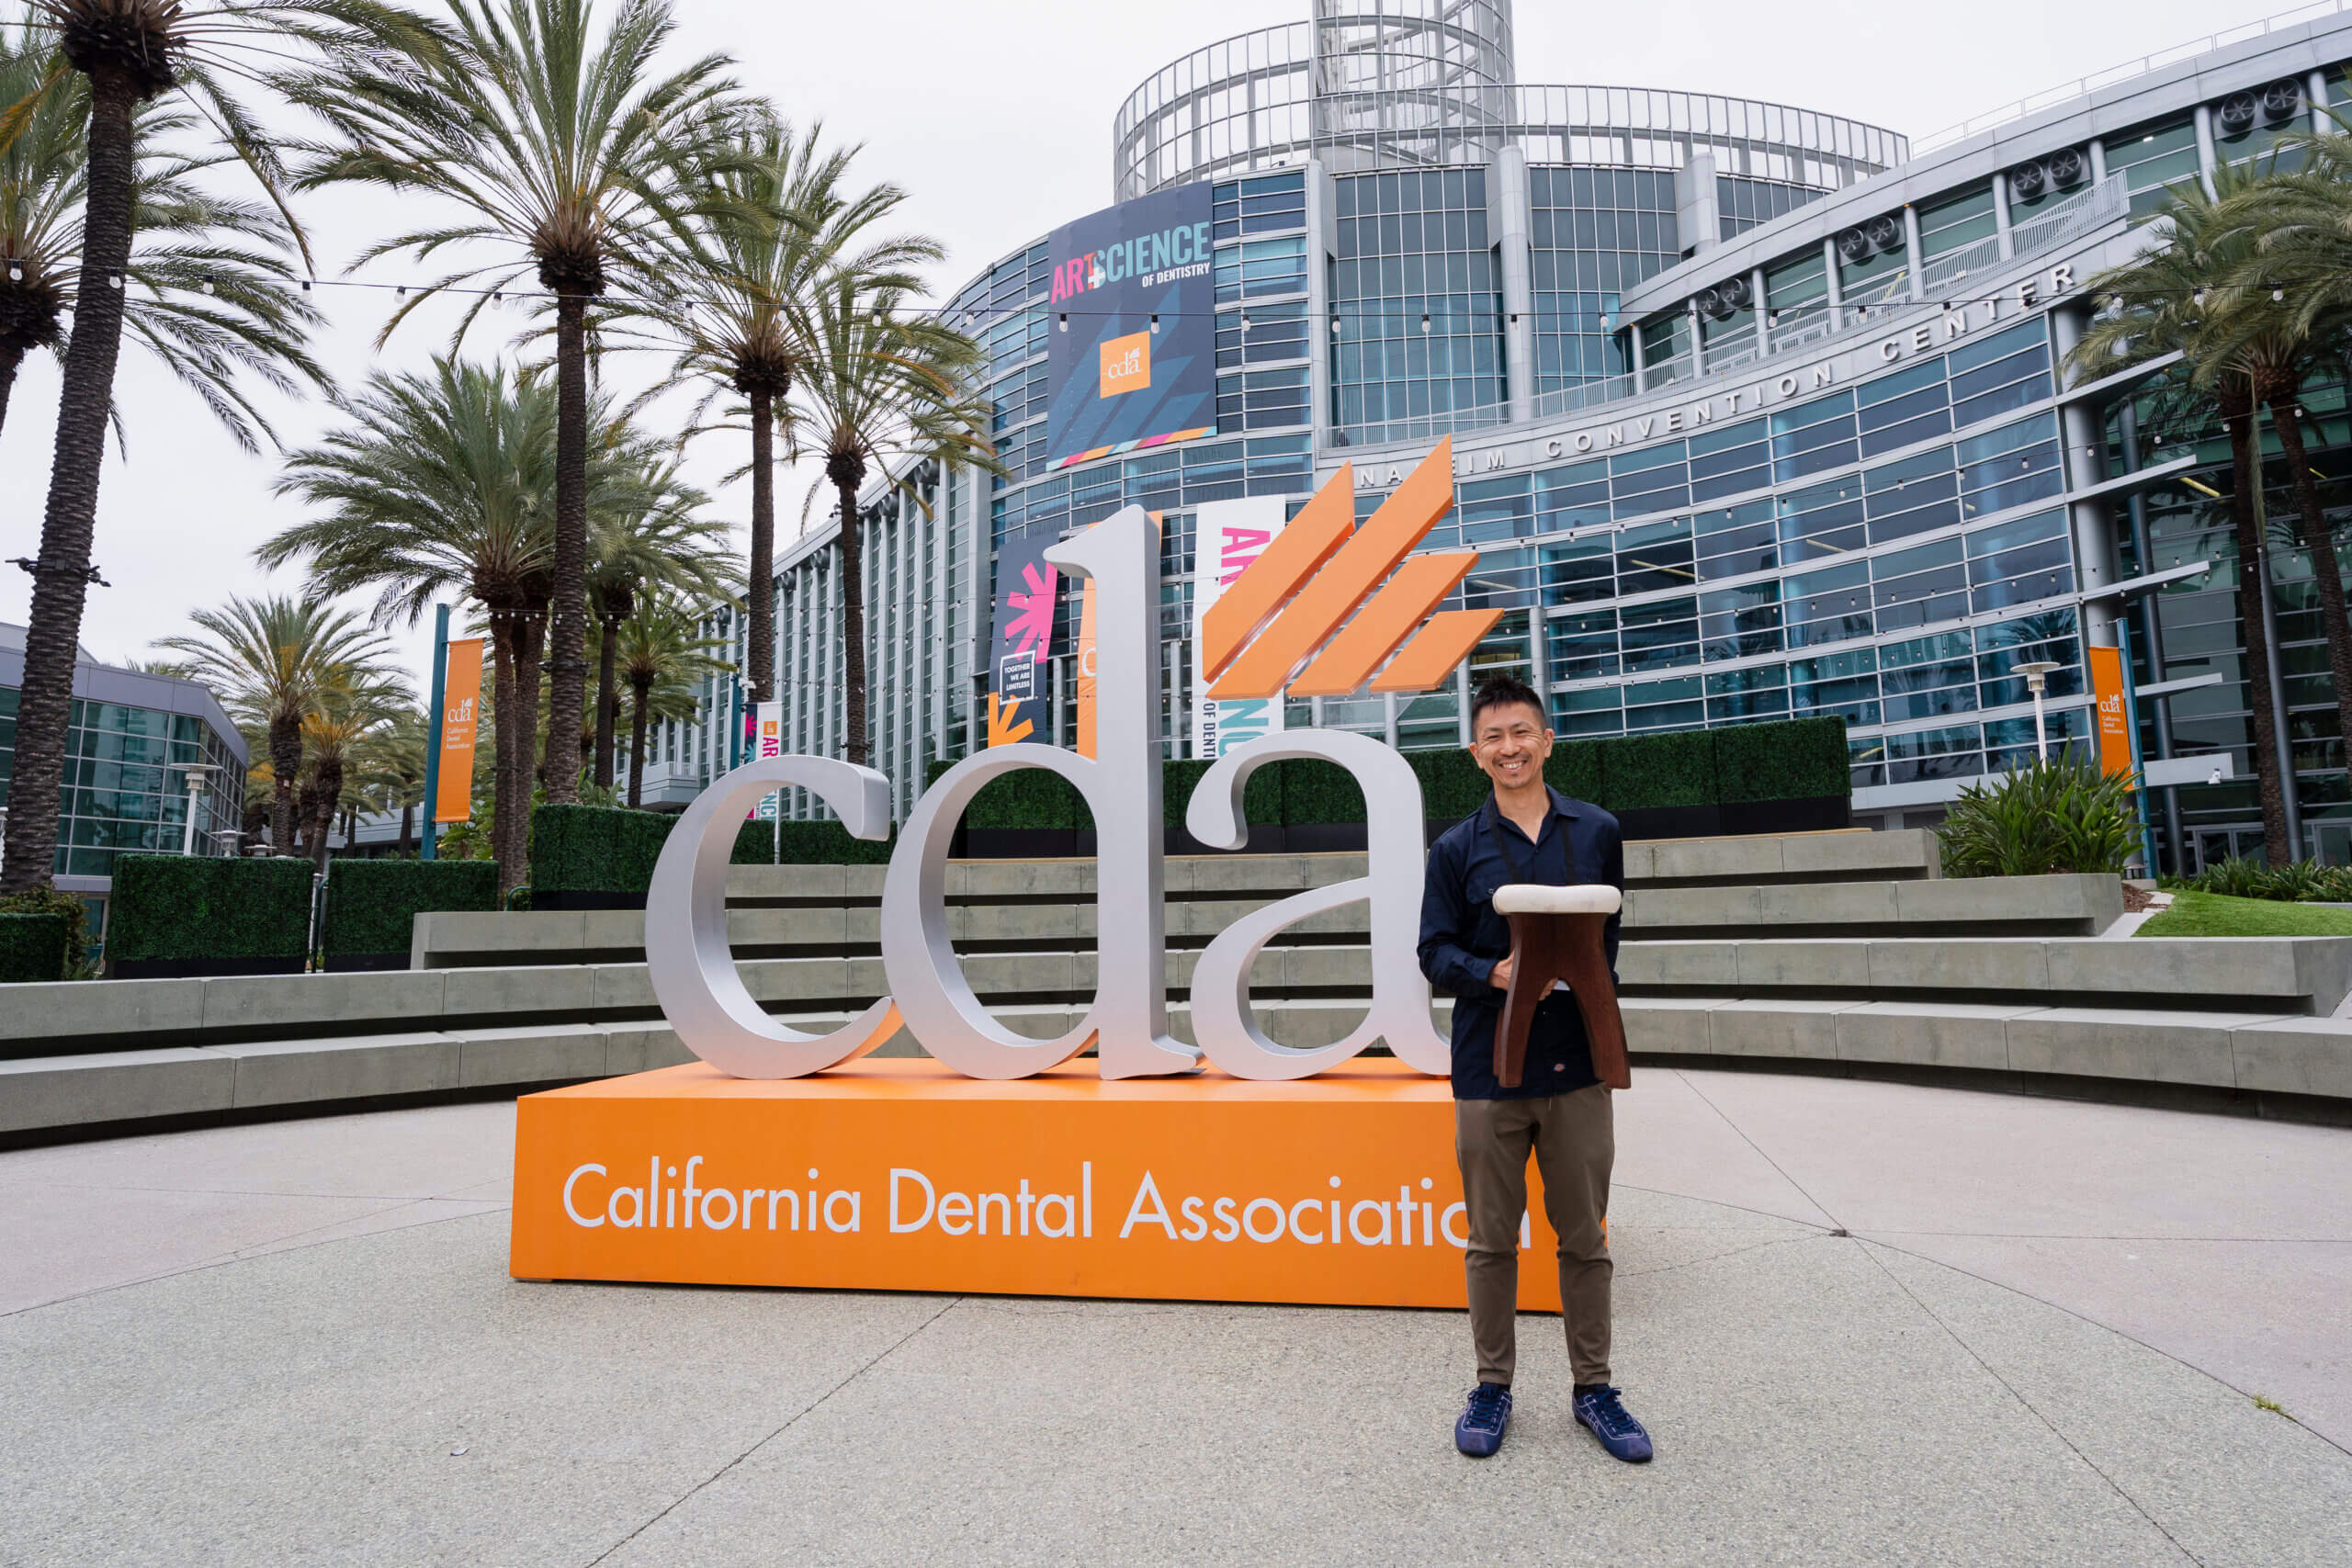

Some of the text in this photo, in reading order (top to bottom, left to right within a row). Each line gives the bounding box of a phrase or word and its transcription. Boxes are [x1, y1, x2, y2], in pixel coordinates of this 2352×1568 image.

[1142, 262, 1211, 288] OF DENTISTRY
[1108, 352, 1140, 378] cda
[1359, 263, 2076, 487] NAIM CONVENTION CENTER
[1004, 663, 1031, 673] TOGETHER
[1006, 681, 1031, 691] LIMITLESS
[447, 699, 471, 722] cda
[2099, 694, 2120, 713] cda
[1203, 703, 1216, 758] OF DENTI
[645, 503, 1453, 1080] cda
[563, 1155, 1532, 1250] California Dental Associatio
